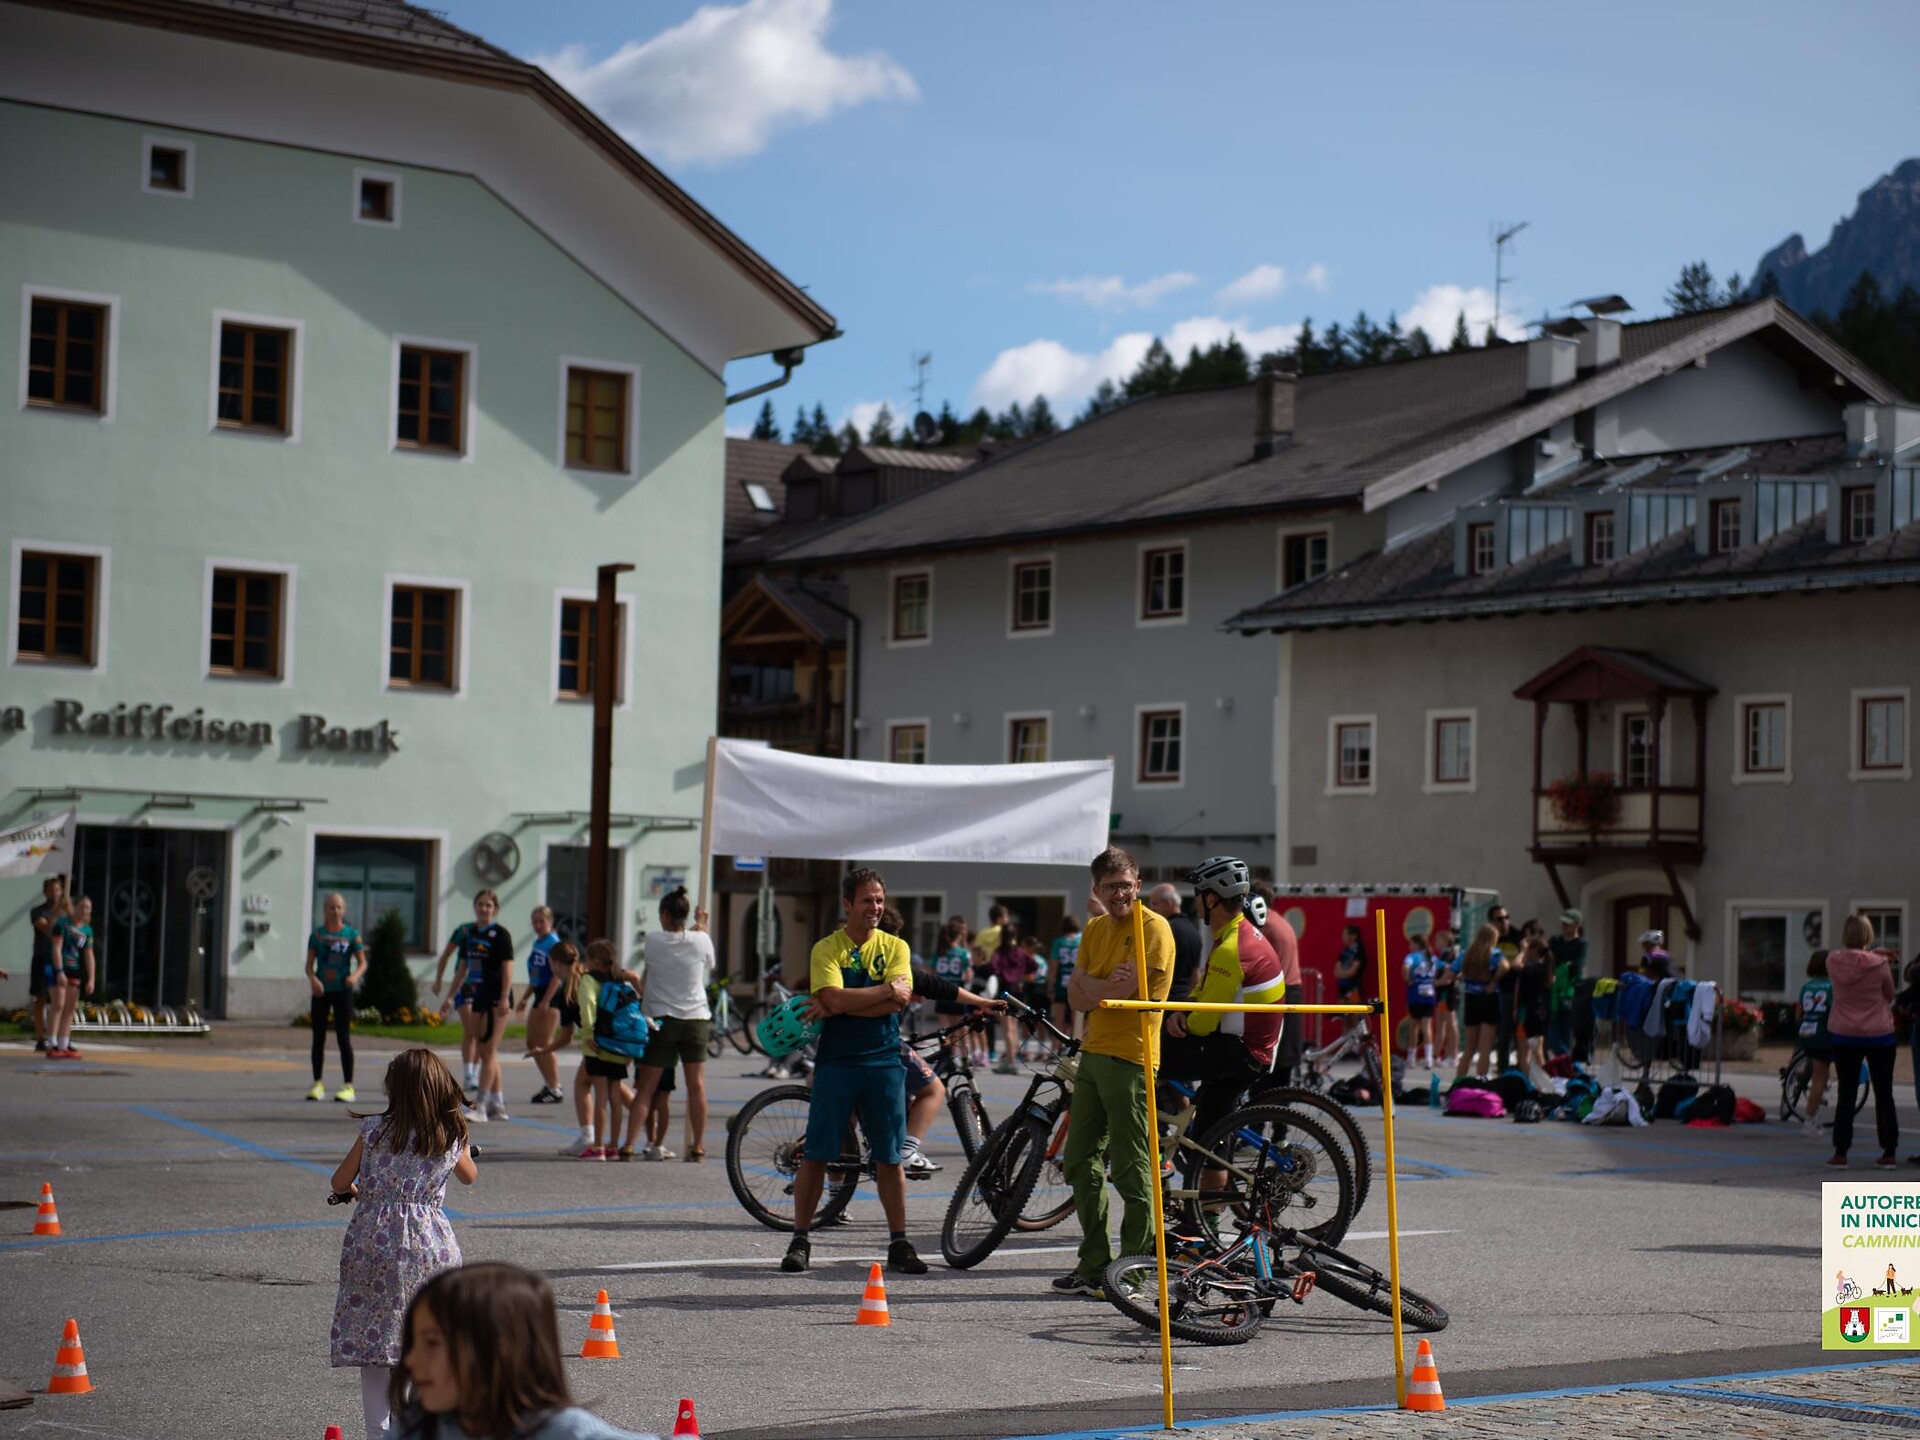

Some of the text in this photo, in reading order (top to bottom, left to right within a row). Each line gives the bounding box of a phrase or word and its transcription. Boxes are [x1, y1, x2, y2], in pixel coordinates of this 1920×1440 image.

[53, 698, 273, 747] Raiffeisen
[299, 713, 400, 754] Bank
[1803, 990, 1827, 1011] 62
